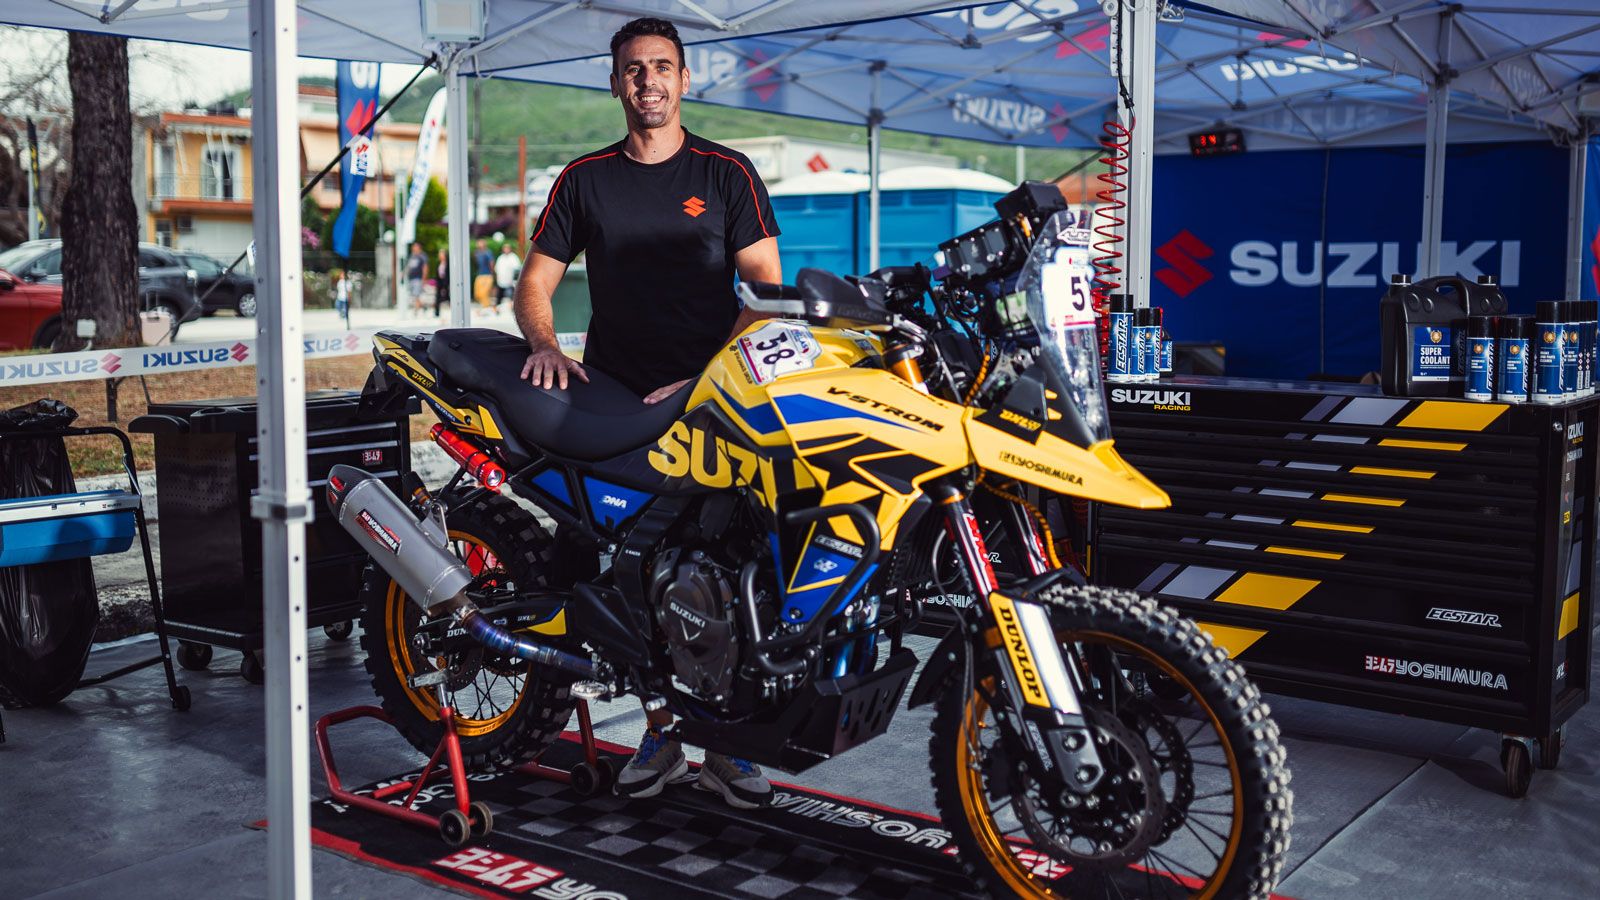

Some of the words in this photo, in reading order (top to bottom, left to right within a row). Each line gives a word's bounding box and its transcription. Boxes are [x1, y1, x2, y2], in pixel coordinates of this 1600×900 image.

[1230, 240, 1521, 288] SUZUKI
[1116, 315, 1128, 374] ECSTAR
[1420, 347, 1442, 356] SUPER
[1420, 356, 1451, 365] COOLANT
[1111, 388, 1191, 405] SUZUKI
[827, 386, 944, 432] V-STROM
[602, 494, 628, 510] DNA
[669, 601, 706, 629] SUZUKI
[1425, 607, 1503, 628] ECSTAR
[447, 628, 467, 638] DUN
[999, 607, 1041, 699] DUNLOP
[1395, 660, 1508, 690] YOSHIMURA
